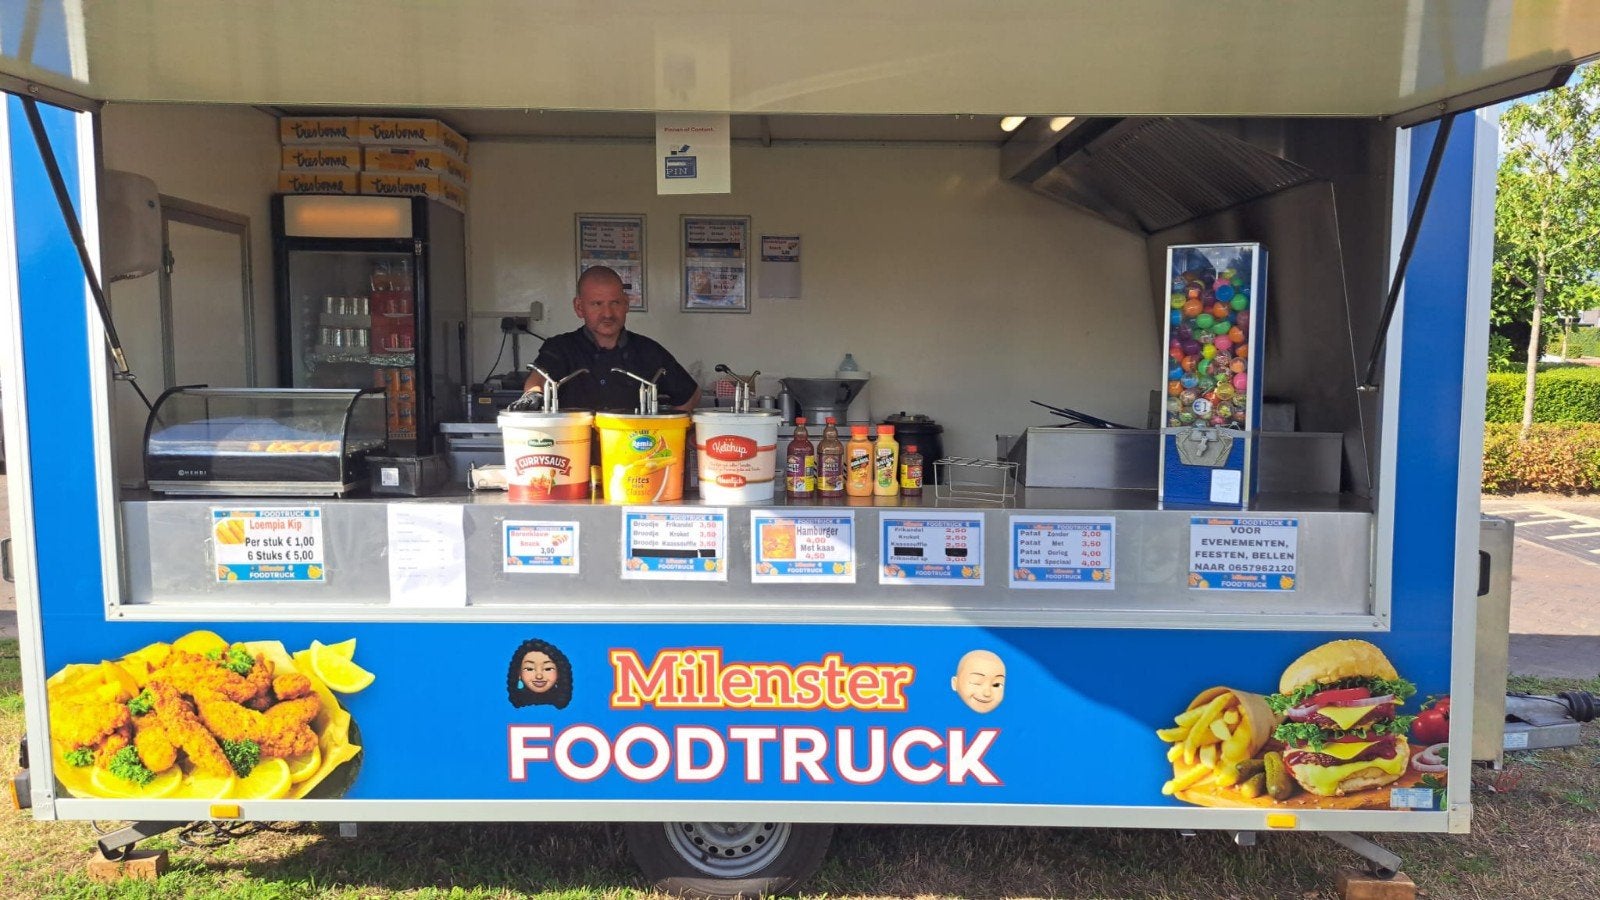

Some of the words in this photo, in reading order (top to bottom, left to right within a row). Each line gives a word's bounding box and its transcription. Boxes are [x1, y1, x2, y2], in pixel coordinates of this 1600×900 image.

[632, 440, 653, 449] Remia
[712, 441, 748, 458] Ketchup
[519, 455, 567, 468] CURRYSAUS
[249, 520, 286, 532] Loempia
[287, 519, 302, 532] Kip
[1230, 526, 1261, 534] VOOR
[796, 526, 839, 538] Hamburger
[245, 537, 260, 547] Per
[263, 536, 284, 547] stuk
[286, 537, 292, 547] €
[295, 536, 315, 548] 1,00
[1201, 538, 1289, 548] EVENEMENTEN,
[247, 551, 254, 560] 6
[256, 550, 283, 560] Stuks
[285, 551, 292, 560] €
[293, 550, 314, 562] 5,00
[1195, 551, 1248, 560] FEESTEN,
[1252, 552, 1294, 560] BELLEN
[1194, 563, 1225, 571] NAAR
[1228, 564, 1294, 572] 0657962120
[610, 647, 915, 709] Milenster
[508, 725, 1002, 786] FOODTRUCK
